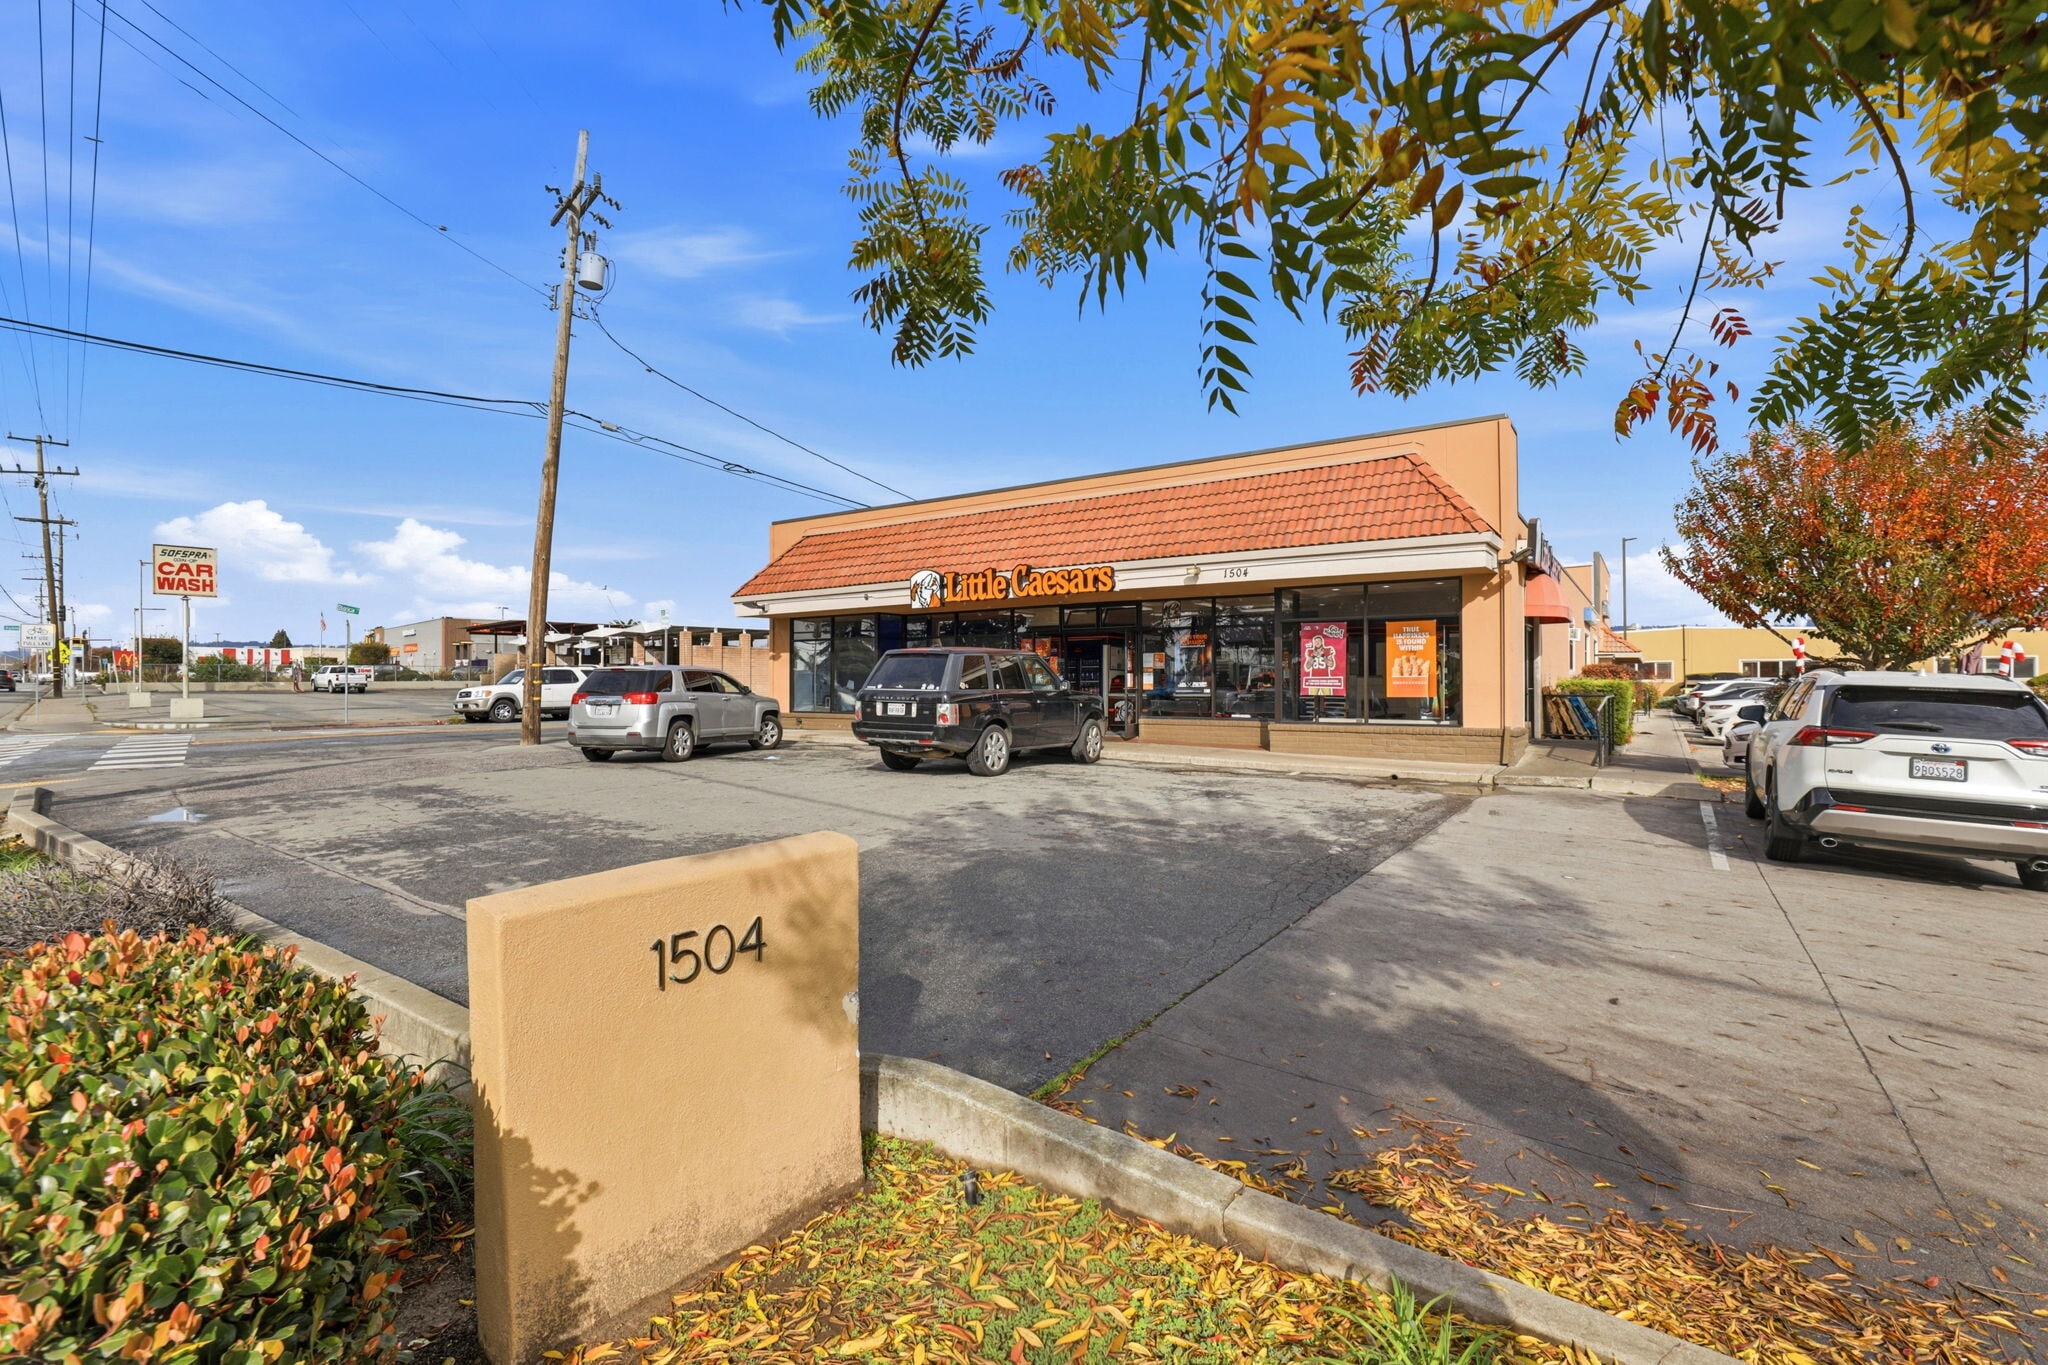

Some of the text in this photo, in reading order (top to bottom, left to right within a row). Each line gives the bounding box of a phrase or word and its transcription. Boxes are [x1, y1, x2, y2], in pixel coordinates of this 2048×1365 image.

[159, 549, 208, 560] SOFSPRA
[158, 561, 213, 578] CAR
[1223, 567, 1248, 579] 1504
[157, 576, 214, 592] WASH
[944, 564, 1115, 602] Little Caesars
[650, 916, 768, 992] 1504
